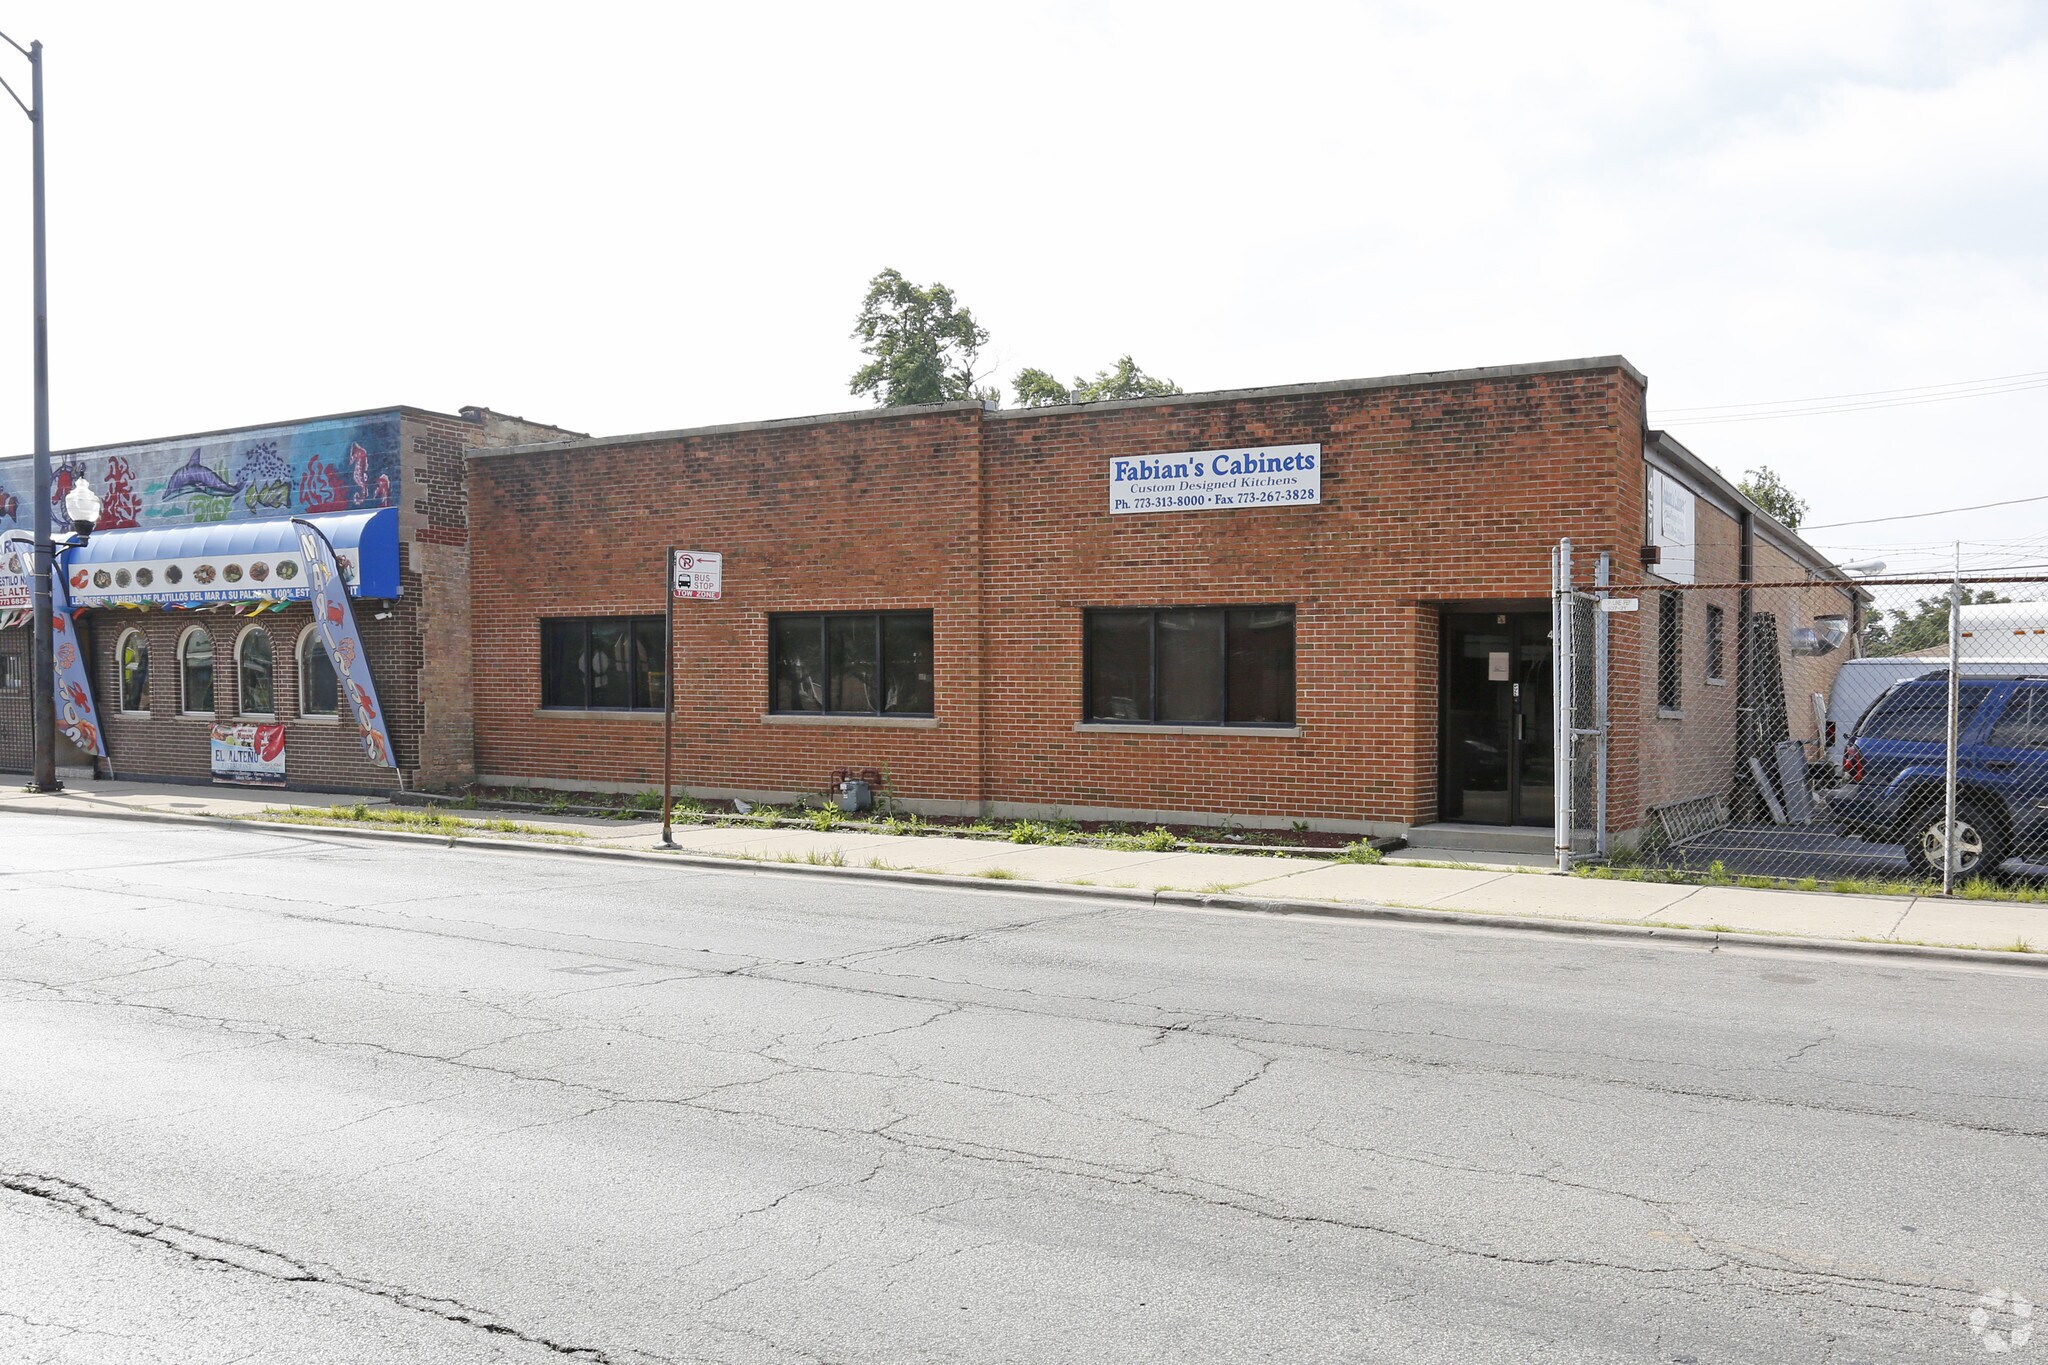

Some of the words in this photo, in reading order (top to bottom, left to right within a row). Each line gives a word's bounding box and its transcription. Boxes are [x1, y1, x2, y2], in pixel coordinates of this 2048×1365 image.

[1114, 457, 1204, 482] Fabian's
[1212, 452, 1315, 476] Cabinets
[1130, 483, 1175, 494] Custom
[1179, 479, 1237, 492] Designed
[1241, 475, 1298, 488] Kitchens
[1114, 499, 1131, 509] Ph.
[1134, 494, 1205, 508] 773-313-8000
[1214, 494, 1234, 505] Fax
[1237, 489, 1315, 503] 773-267-3828
[694, 574, 711, 582] BUS
[694, 582, 714, 590] STOP
[9, 586, 29, 596] ALTE
[110, 594, 142, 604] VARIEDAD
[153, 592, 189, 602] PLATILLOS
[190, 591, 203, 601] DEL
[205, 591, 220, 601] MAR
[221, 590, 228, 600] A
[229, 590, 238, 600] SU
[295, 588, 310, 597] EST
[215, 749, 225, 762] EL
[228, 747, 259, 764] ALTEÑO
